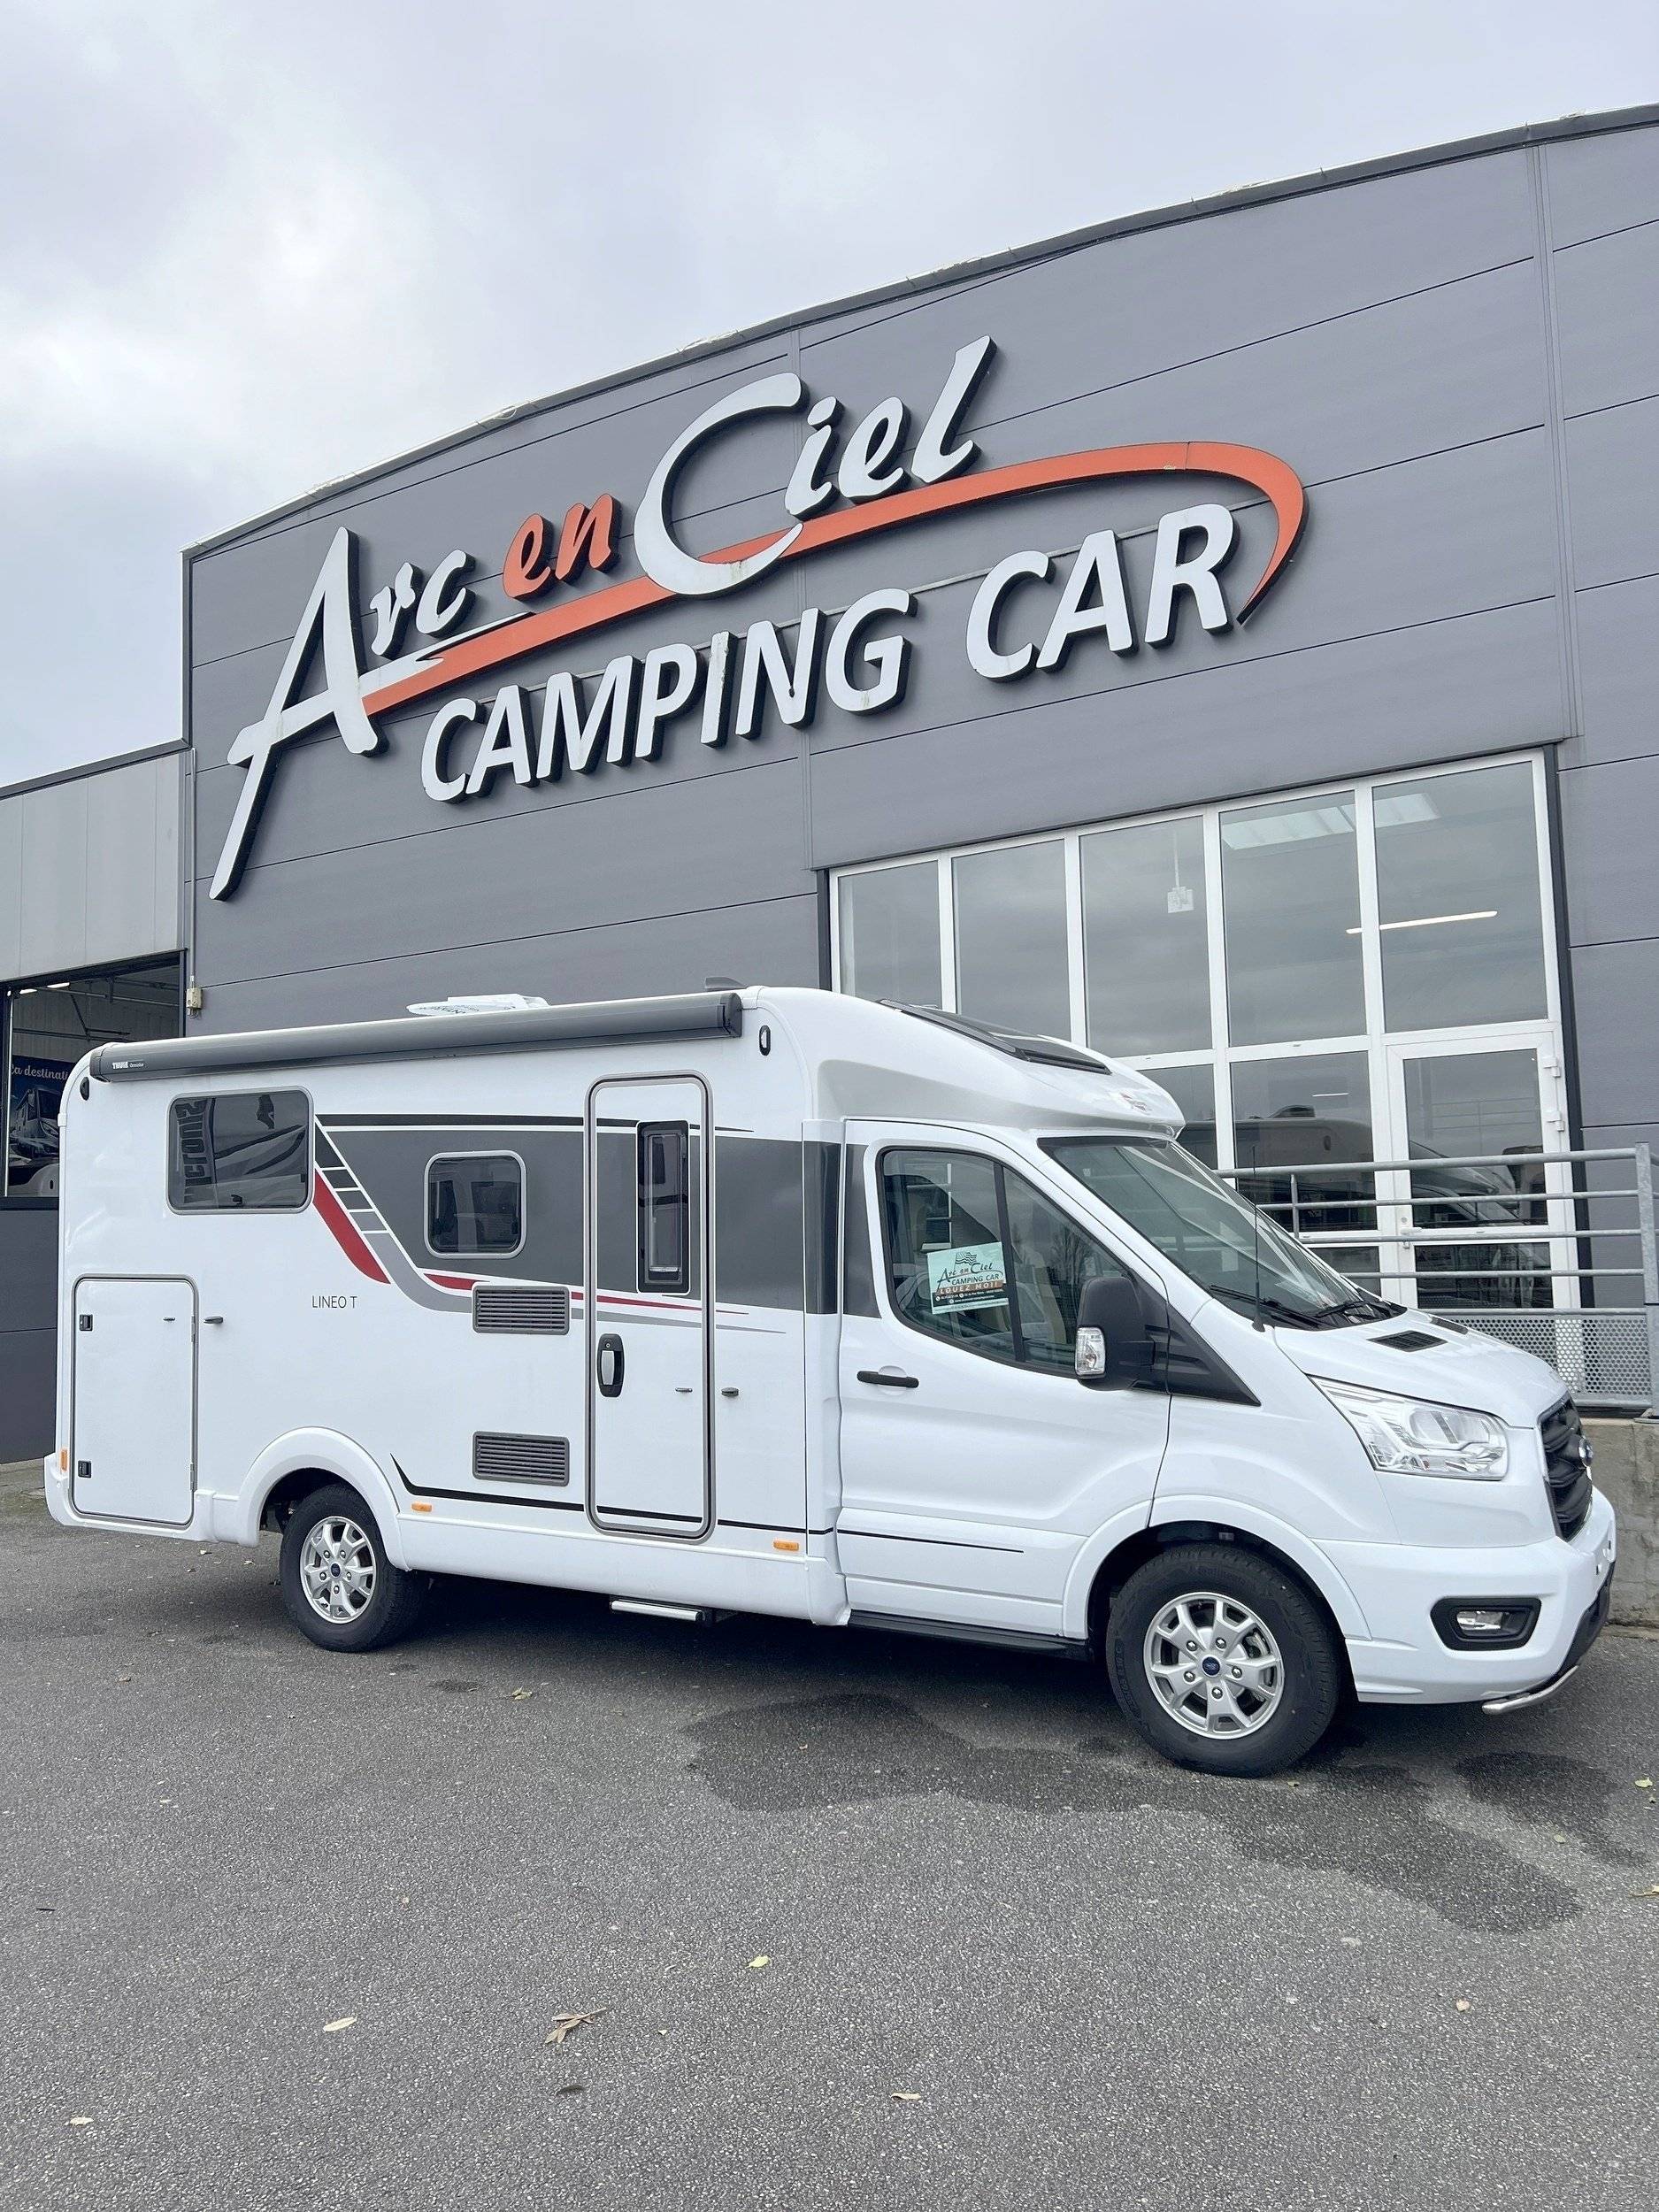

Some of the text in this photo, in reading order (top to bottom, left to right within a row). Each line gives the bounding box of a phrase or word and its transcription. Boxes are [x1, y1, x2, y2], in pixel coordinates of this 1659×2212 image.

[209, 335, 992, 901] Arc en Ciel
[420, 503, 1235, 803] CAMPING CAR
[311, 1295, 357, 1309] LINEO T
[951, 1274, 984, 1286] CAMPING
